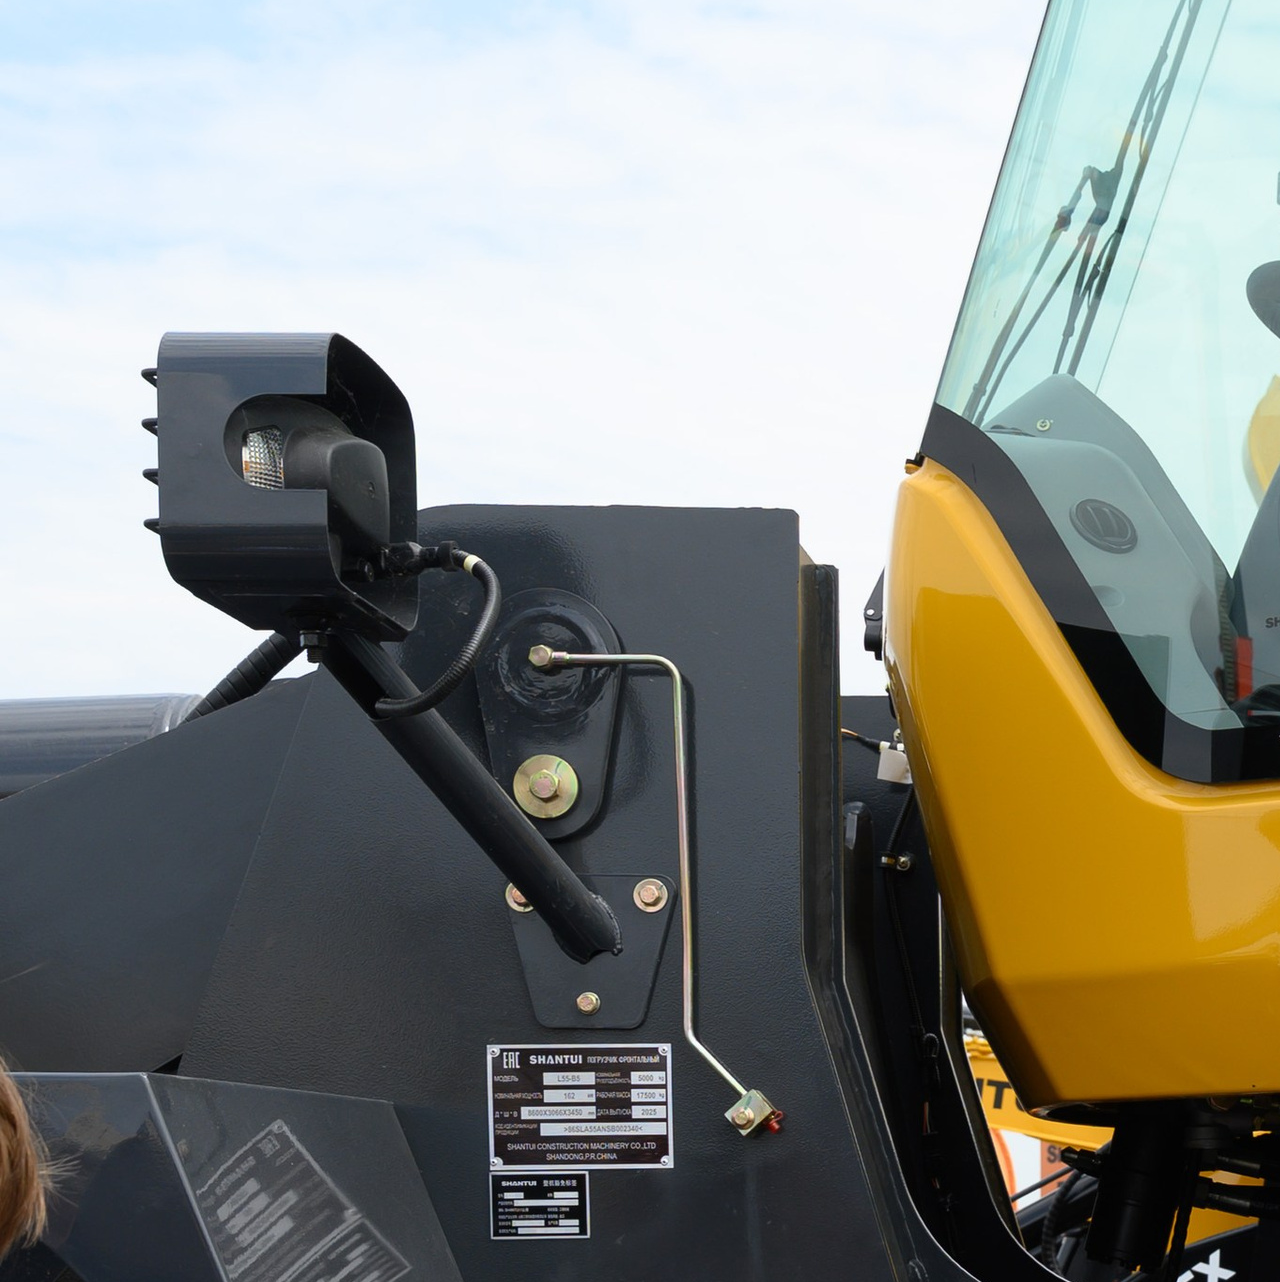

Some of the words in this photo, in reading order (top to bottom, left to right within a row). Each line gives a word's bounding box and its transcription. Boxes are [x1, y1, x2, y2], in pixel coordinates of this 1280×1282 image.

[529, 1054, 583, 1064] SHANTUI
[587, 1056, 618, 1064] ПОГРУЗЧИК
[619, 1054, 660, 1064] ФРОНТАЛЬНЫЙ
[557, 1075, 581, 1083] L55-B5
[637, 1092, 656, 1100] 17500
[641, 1108, 657, 1116] 2025
[507, 1143, 536, 1151] SHANTUI
[537, 1142, 590, 1150] CONSTRUCTION
[590, 1142, 629, 1150] MACHINERY
